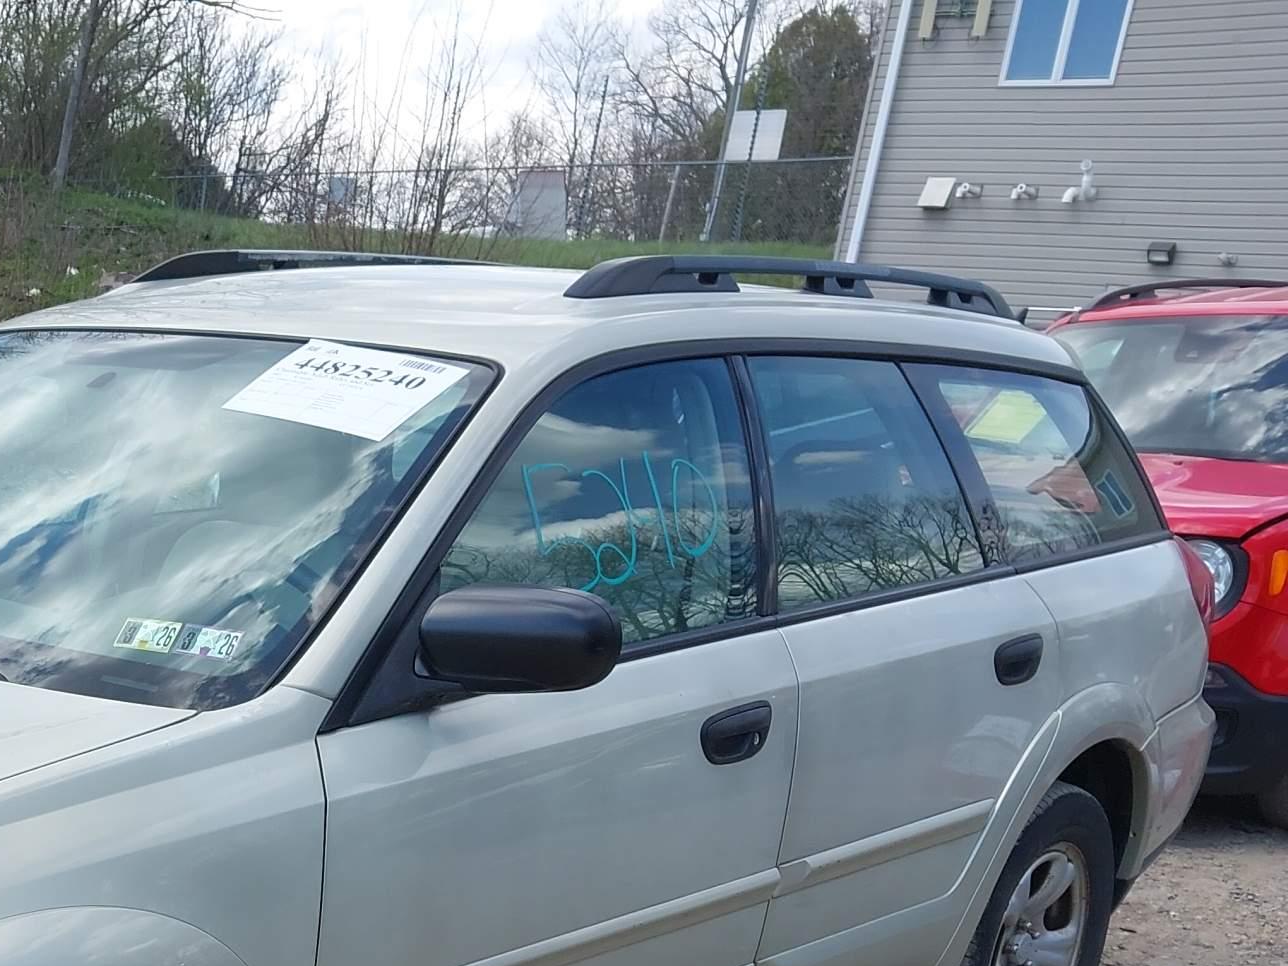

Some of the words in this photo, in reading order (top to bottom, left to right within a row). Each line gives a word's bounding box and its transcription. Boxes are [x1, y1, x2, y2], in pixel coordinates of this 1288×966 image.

[294, 357, 427, 390] 44825240
[122, 625, 138, 644] 3
[155, 626, 178, 647] 26
[181, 631, 197, 651] 3
[217, 633, 240, 656] 26
